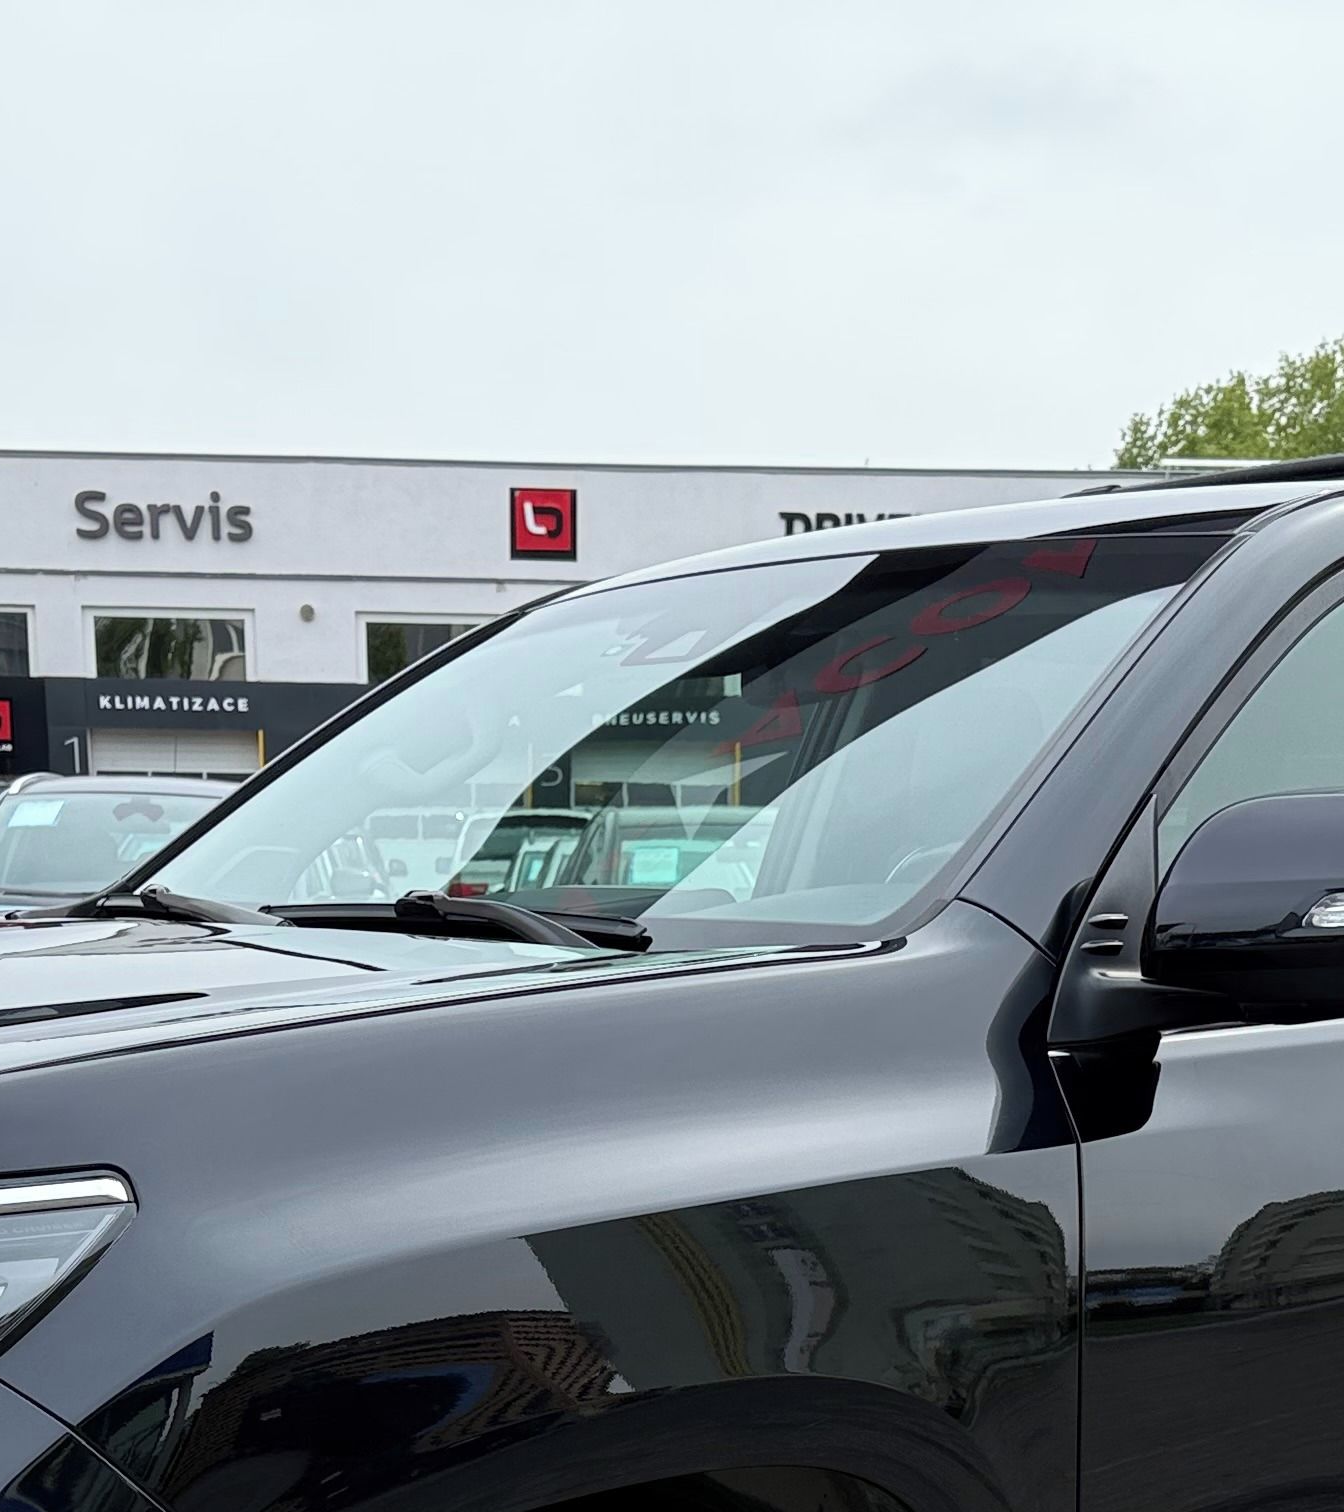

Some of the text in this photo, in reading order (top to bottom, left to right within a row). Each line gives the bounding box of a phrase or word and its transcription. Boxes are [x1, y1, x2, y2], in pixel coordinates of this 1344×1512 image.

[74, 490, 254, 543] Servis
[99, 695, 249, 712] KLIMATIZACE
[64, 736, 81, 774] 1
